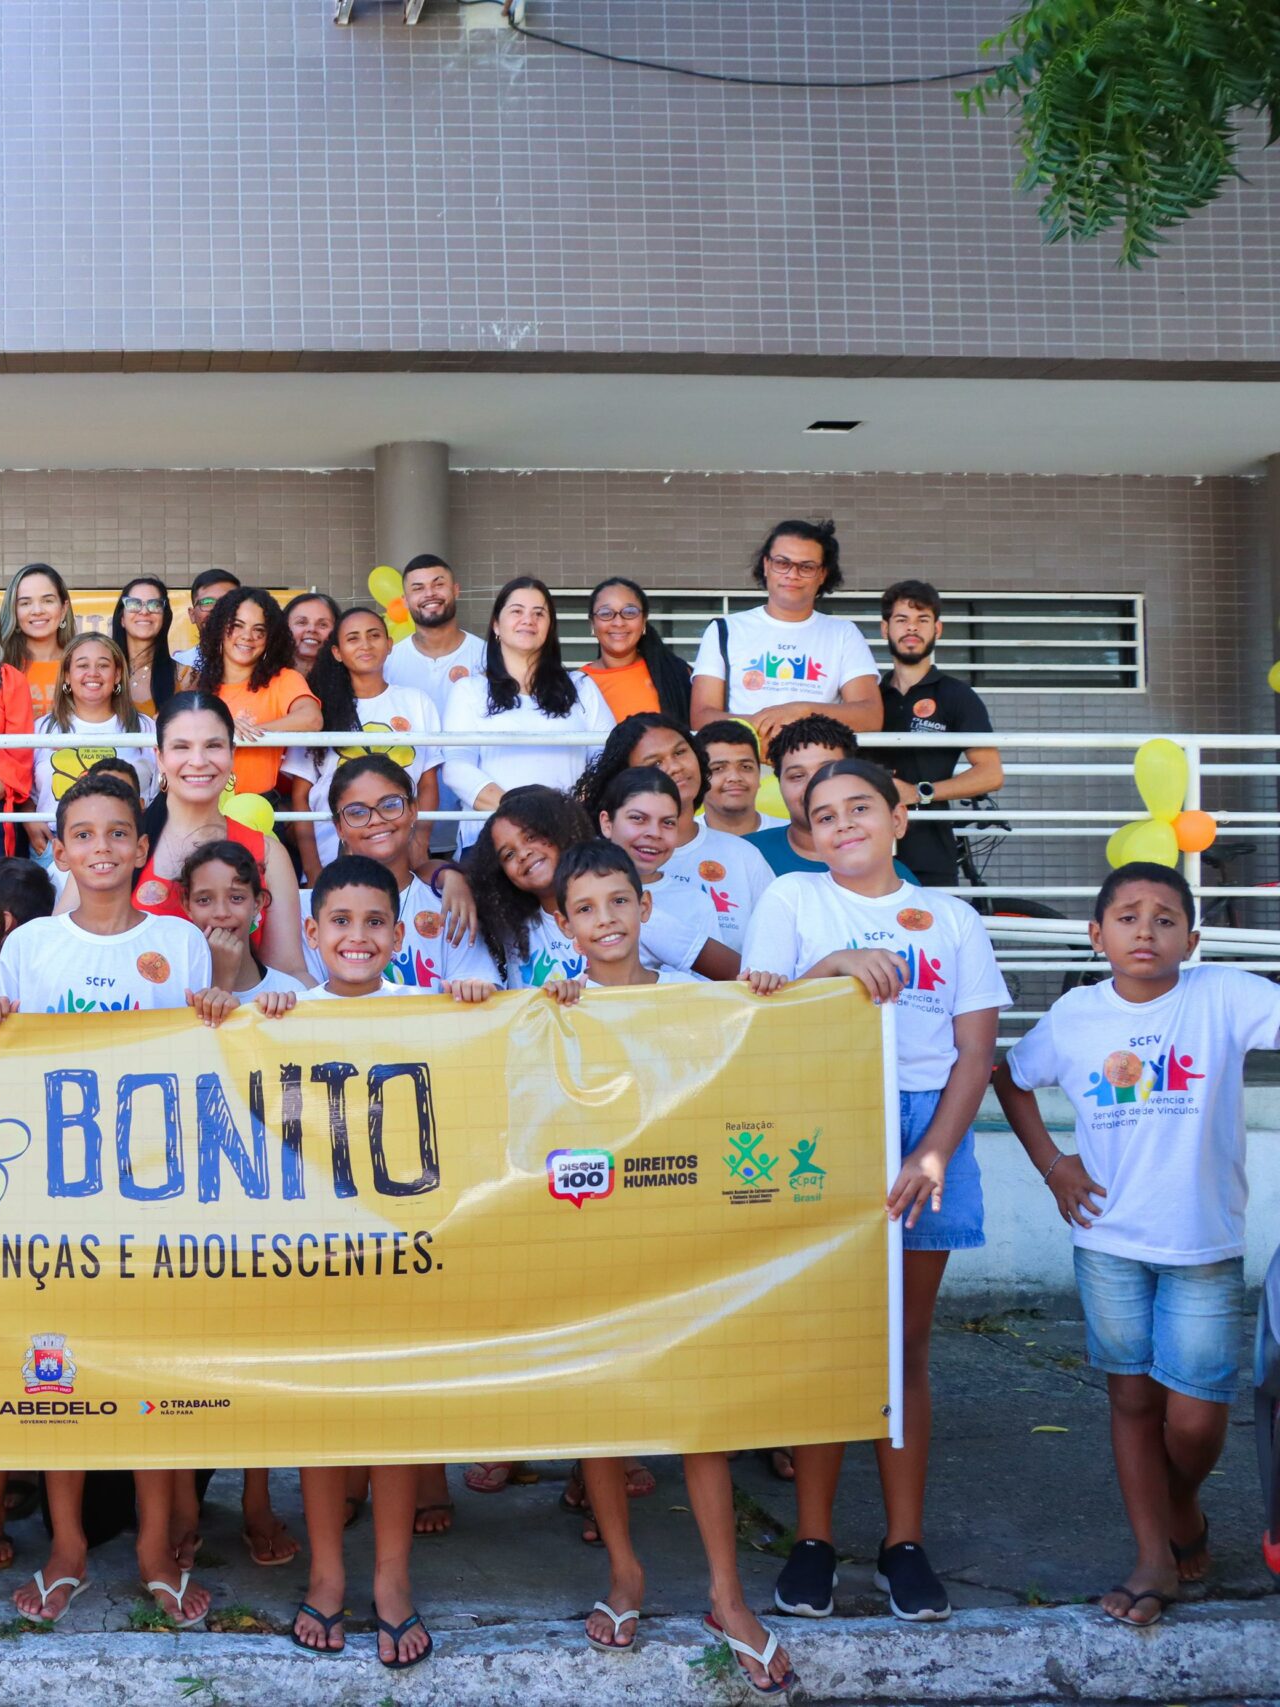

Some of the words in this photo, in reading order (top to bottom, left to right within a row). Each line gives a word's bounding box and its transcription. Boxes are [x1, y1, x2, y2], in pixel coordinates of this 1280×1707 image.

[864, 931, 895, 941] SCFV
[86, 976, 116, 987] SCFV
[1129, 1034, 1162, 1047] SCFV
[1093, 1109, 1127, 1120] Serviço
[725, 1121, 775, 1131] Realização:
[1091, 1118, 1138, 1130] Fortalecim
[44, 1062, 441, 1204] BONITO
[559, 1161, 605, 1172] DISQUE
[624, 1155, 698, 1173] DIREITOS
[558, 1171, 604, 1188] 100
[624, 1172, 698, 1188] HUMANOS
[120, 1234, 135, 1279] E
[153, 1231, 444, 1279] ADOLESCENTES.
[160, 1400, 169, 1408] O
[171, 1399, 231, 1408] TRABALHO
